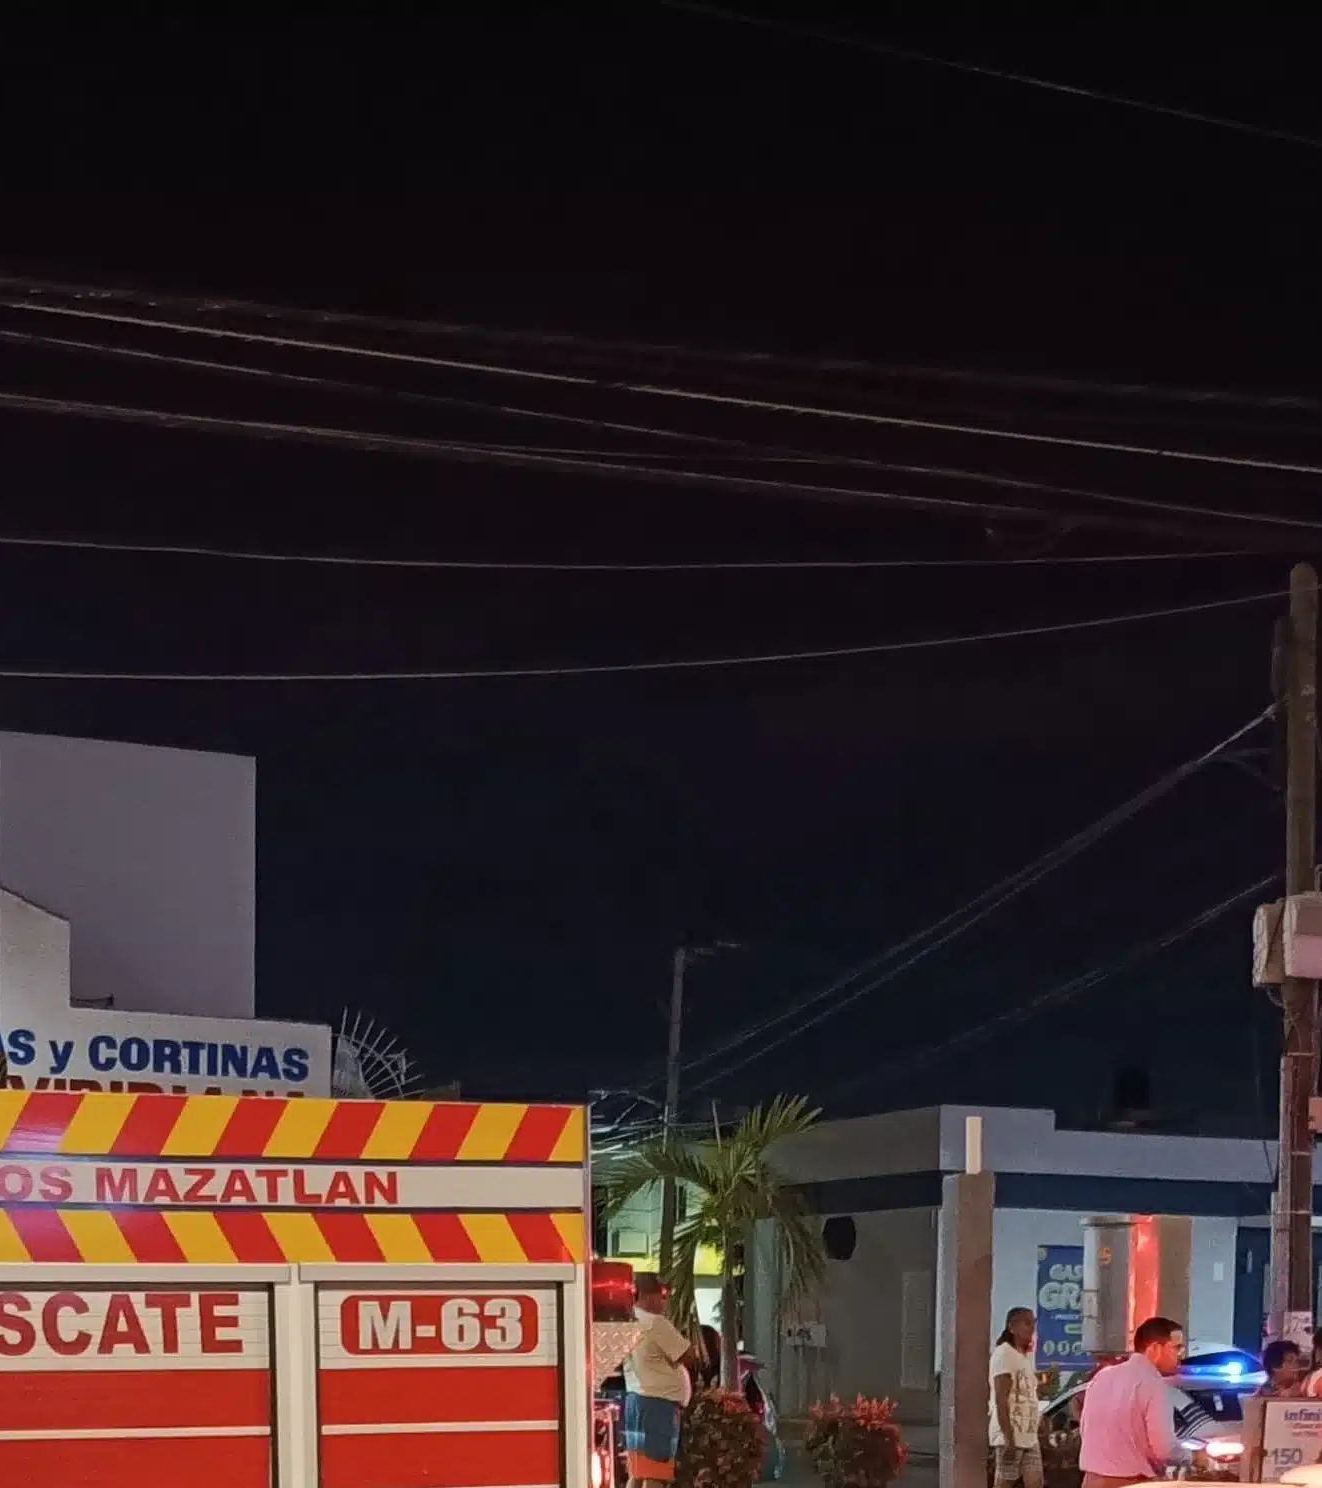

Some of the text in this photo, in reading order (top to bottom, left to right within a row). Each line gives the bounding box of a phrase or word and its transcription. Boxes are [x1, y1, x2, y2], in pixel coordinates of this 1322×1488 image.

[48, 1040, 75, 1074] y
[88, 1035, 309, 1082] CORTINAS
[95, 1166, 399, 1205] MAZATLAN
[357, 1298, 523, 1351] M-63
